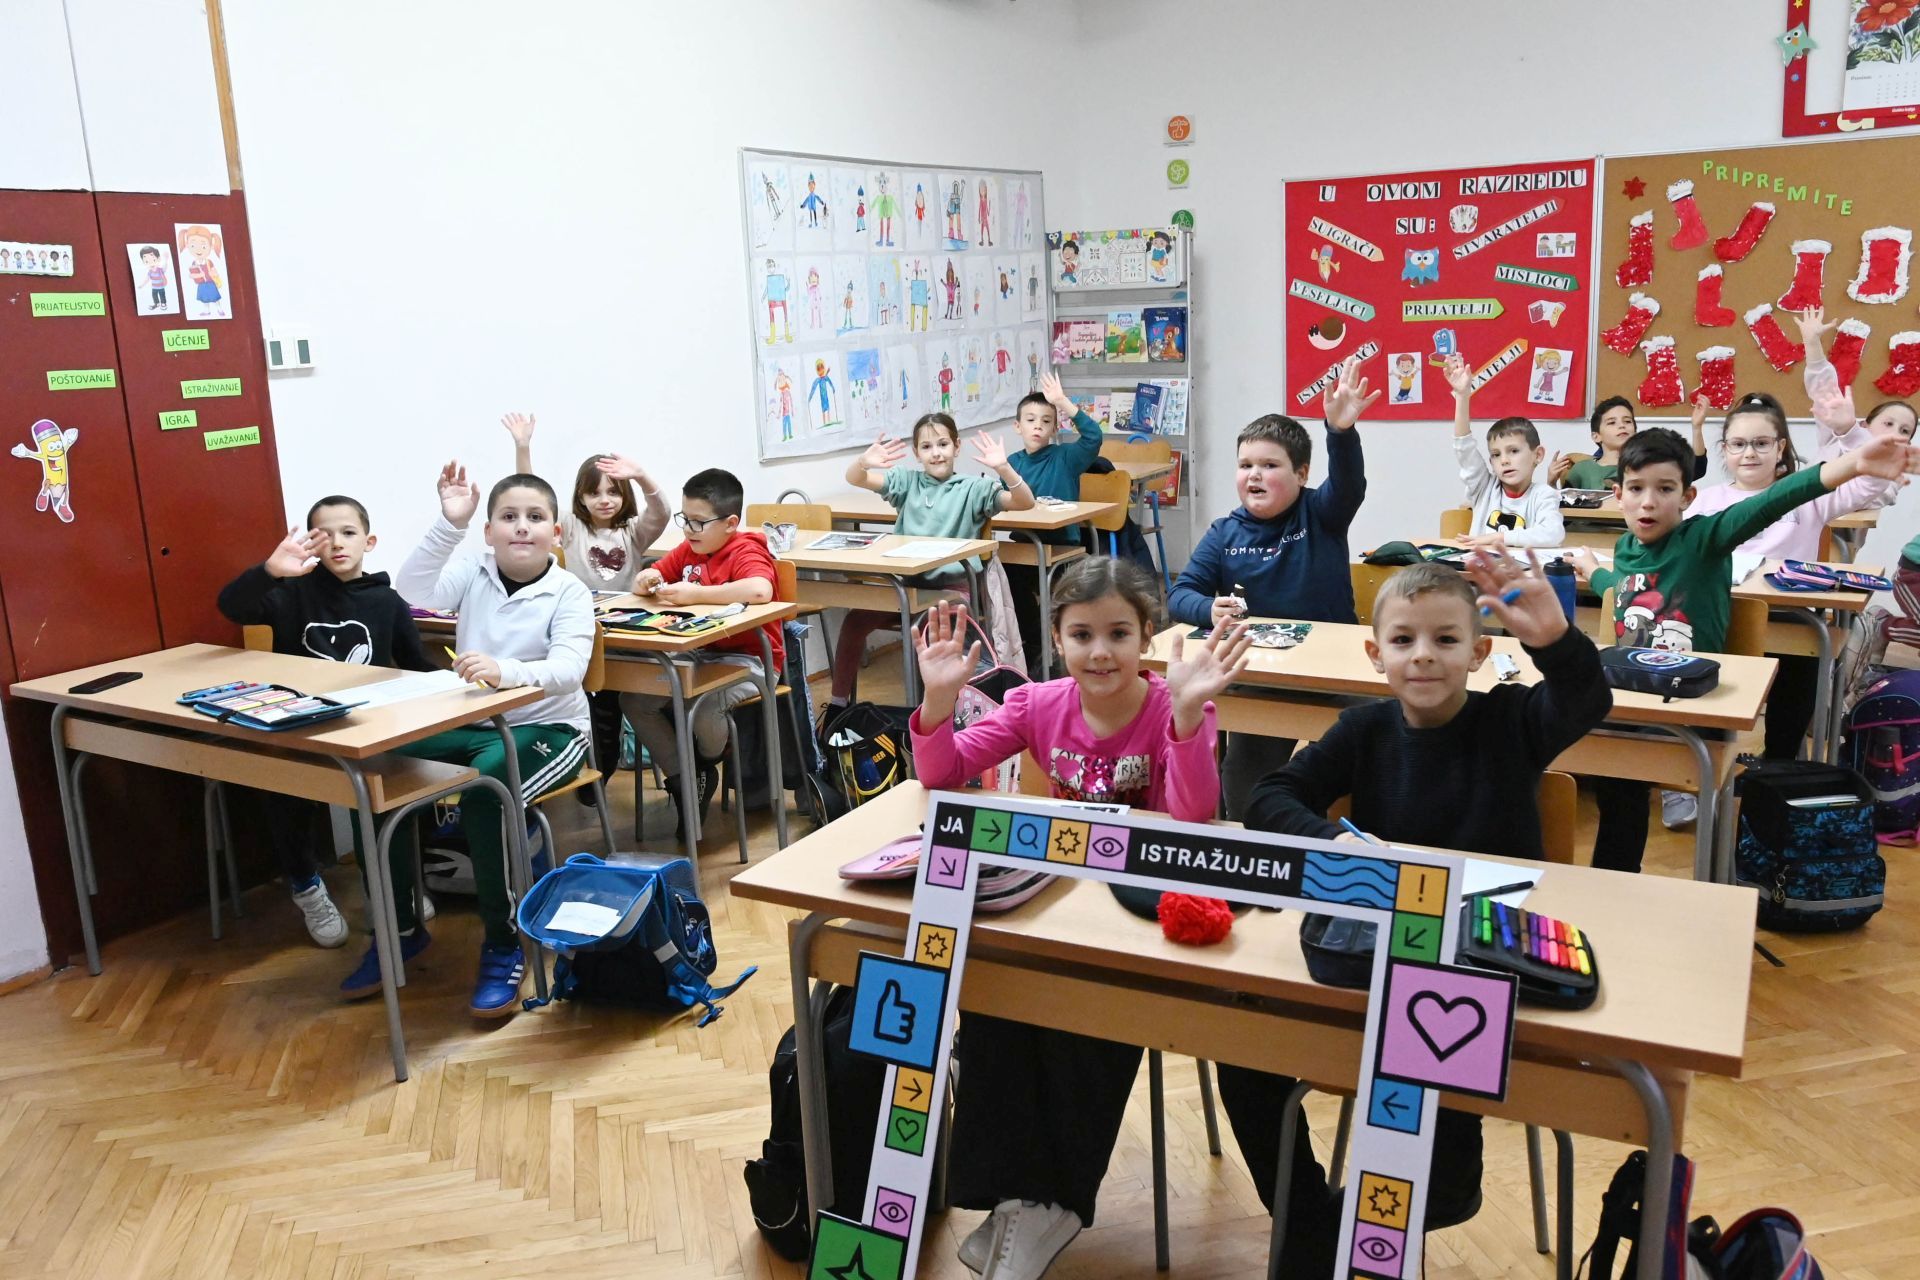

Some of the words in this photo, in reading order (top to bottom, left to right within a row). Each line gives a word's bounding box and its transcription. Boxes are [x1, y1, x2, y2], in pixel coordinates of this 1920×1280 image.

[1320, 185, 1334, 201] U
[1367, 182, 1440, 201] OVOM
[1460, 169, 1586, 194] RAZREDU
[1702, 160, 1853, 216] PRIPREMITE
[1311, 219, 1374, 257] SUIGRAČI
[1454, 201, 1556, 258] STVARATELJI
[1498, 267, 1569, 290] MISLIOCI
[34, 301, 101, 311] PRIJATELJSTVO
[1293, 281, 1366, 317] VESELJACI
[1404, 302, 1492, 316] PRIJATELJI
[166, 334, 207, 347] UČENJE
[50, 373, 112, 385] POŠTOVANJE
[1298, 341, 1378, 404] ISTRAŽAČI
[184, 382, 239, 394] ISTRAŽIVANJE
[165, 414, 190, 426] IGRA
[207, 432, 258, 447] UVAŽAVANJE
[1224, 546, 1264, 556] TOMMY
[939, 816, 965, 835] JA
[1139, 842, 1292, 882] ISTRAŽUJEM
